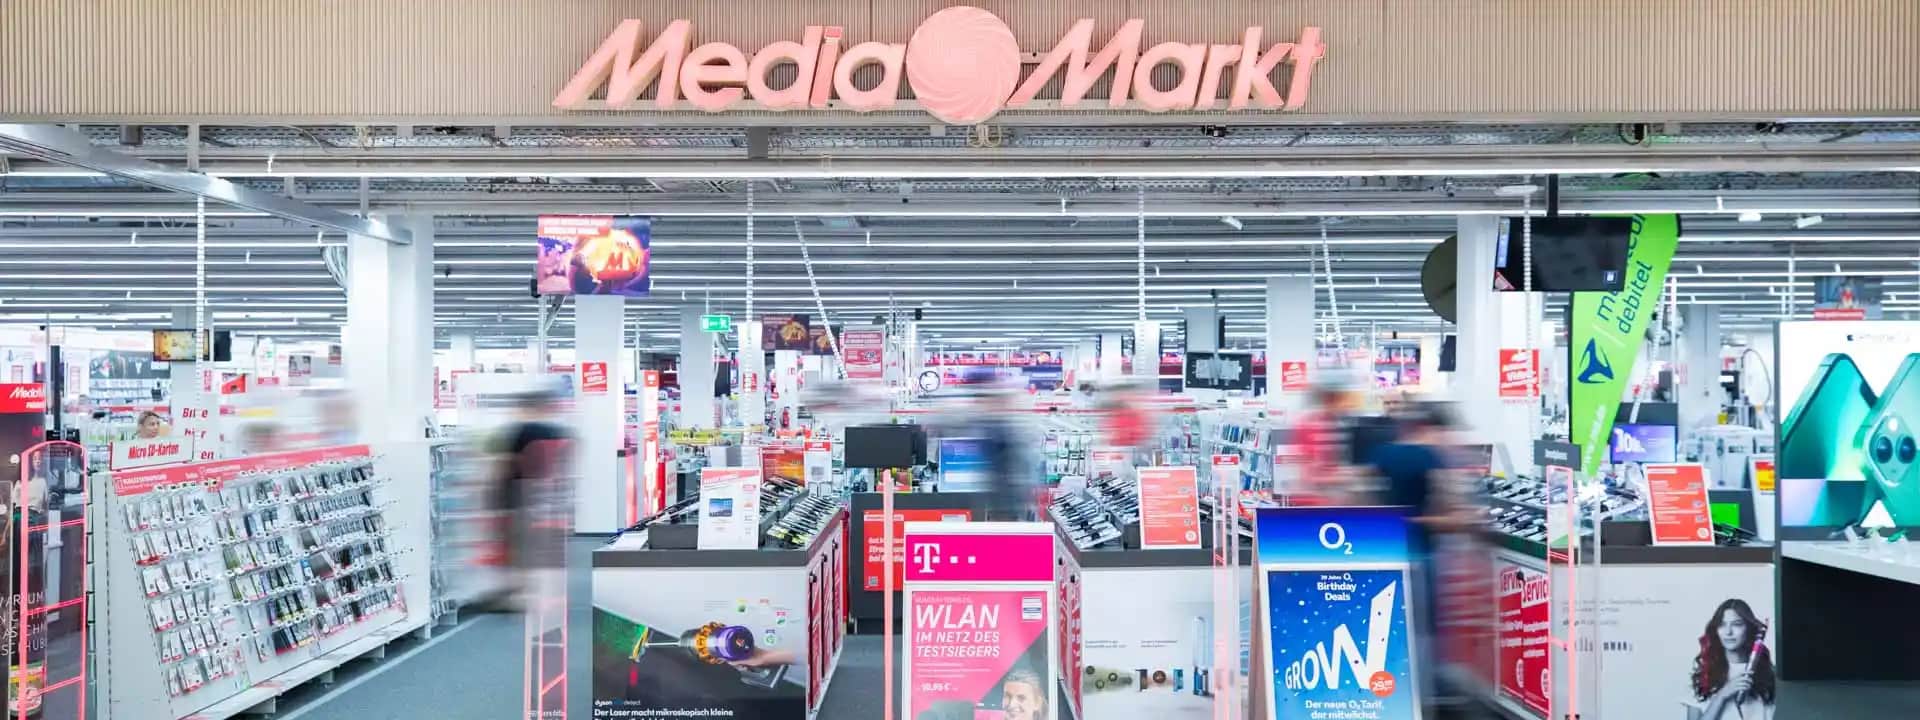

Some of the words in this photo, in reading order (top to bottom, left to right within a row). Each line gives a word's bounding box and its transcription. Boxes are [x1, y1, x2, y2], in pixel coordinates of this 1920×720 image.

[552, 18, 907, 108] Media
[1005, 18, 1326, 109] Markt
[1616, 261, 1653, 334] debitel
[128, 446, 147, 459] Micro
[147, 443, 179, 457] SD-Karten
[1317, 582, 1357, 593] Birthday
[1325, 592, 1351, 601] Deals
[915, 604, 1000, 629] WLAN
[916, 632, 932, 643] IM
[936, 632, 970, 643] NETZ
[974, 632, 1000, 643] DES
[1285, 580, 1396, 690] GROW
[916, 645, 1000, 657] TESTSIEGERS
[1305, 700, 1322, 709] Der
[1324, 701, 1346, 709] neue
[631, 708, 655, 716] macht
[656, 708, 709, 718] mikroskopisch
[710, 708, 733, 716] kleine
[1311, 710, 1326, 719] der
